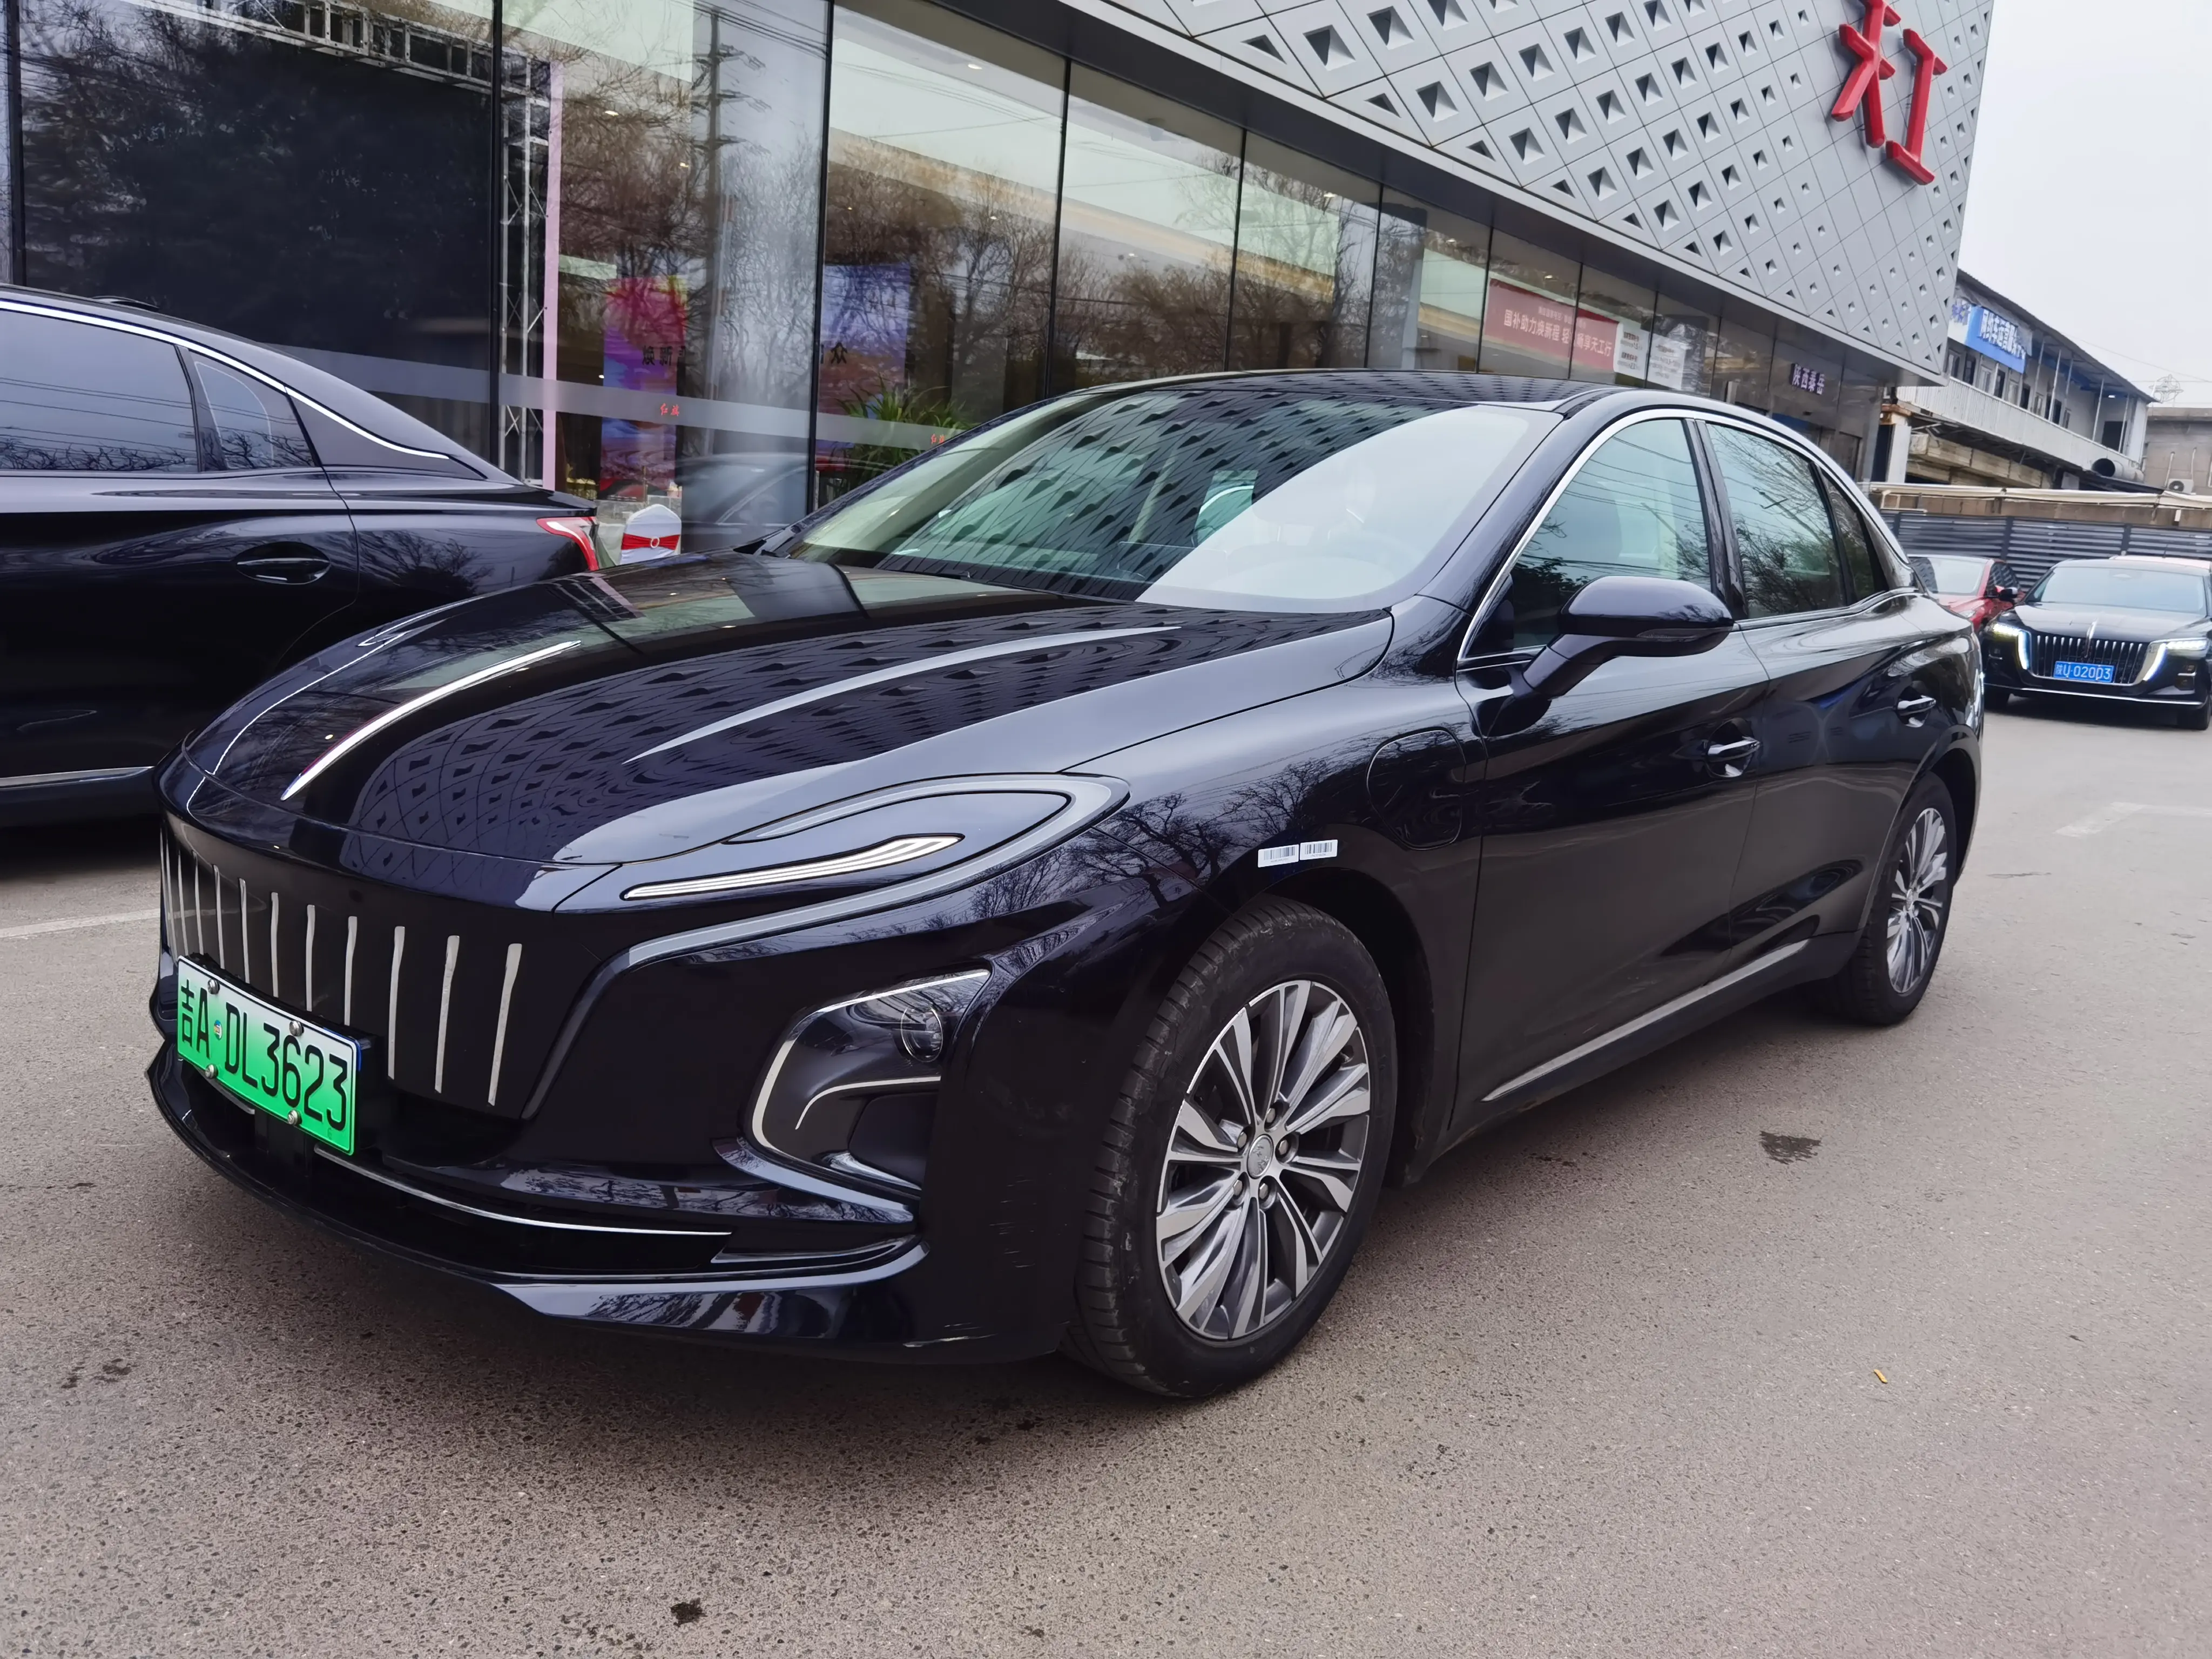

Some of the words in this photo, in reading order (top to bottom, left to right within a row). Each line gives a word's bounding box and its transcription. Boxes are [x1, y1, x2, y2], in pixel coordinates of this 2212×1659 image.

[1561, 327, 1612, 356] 轻畅享天工行
